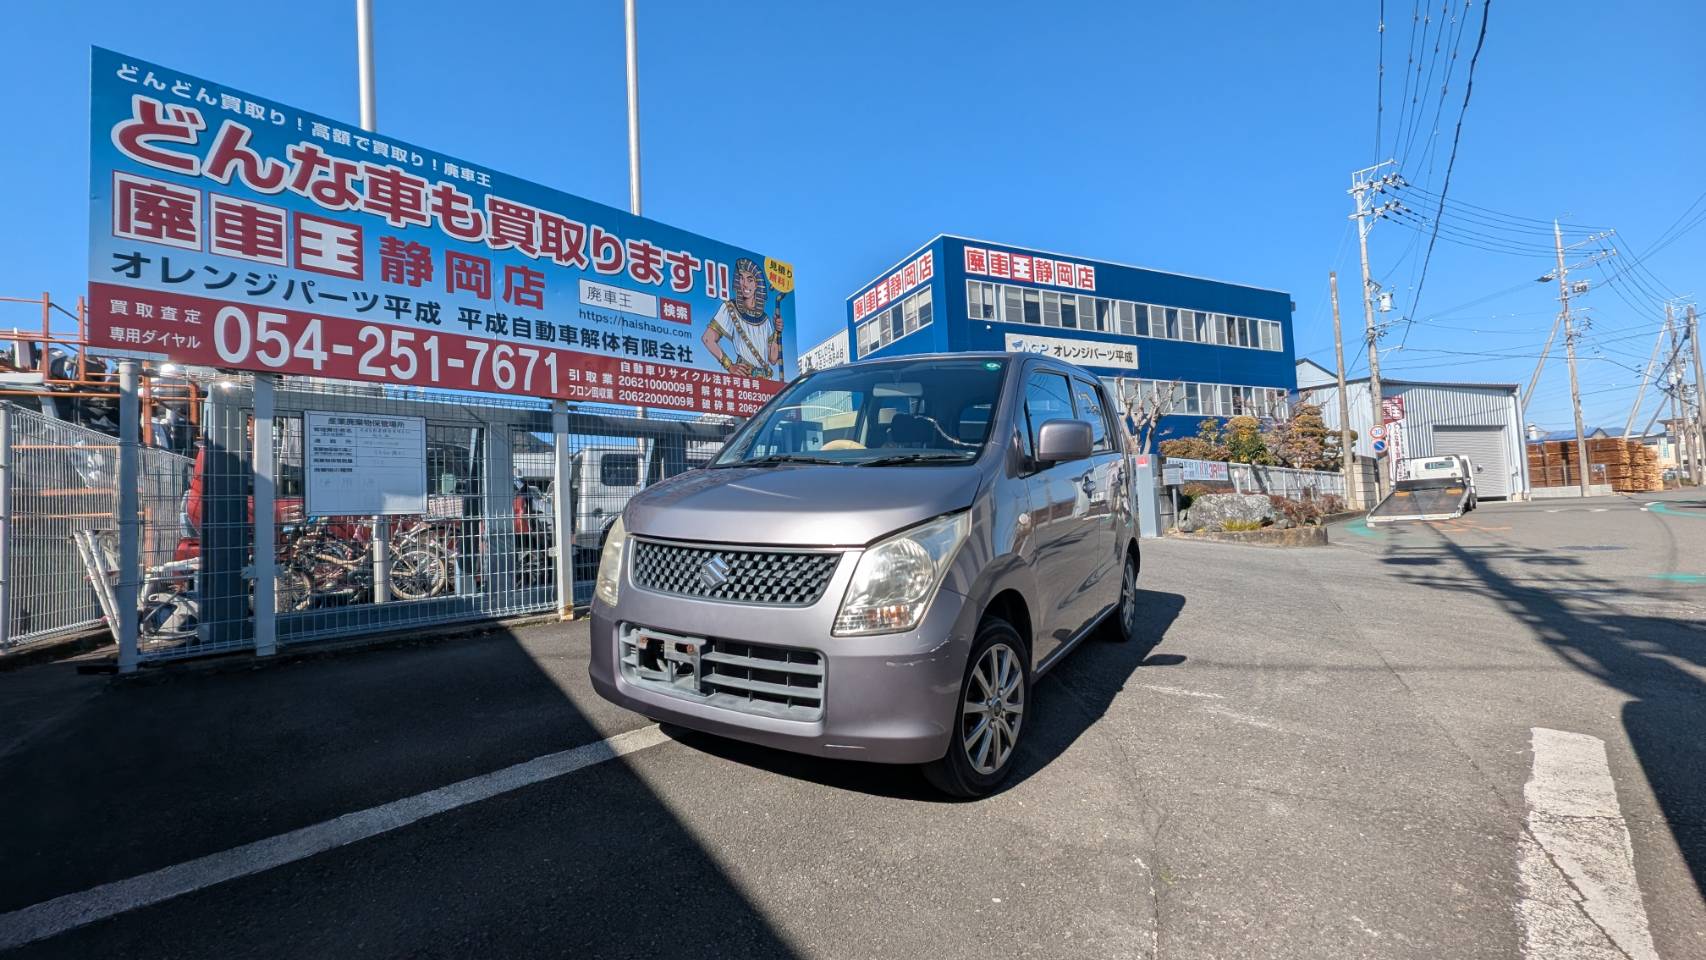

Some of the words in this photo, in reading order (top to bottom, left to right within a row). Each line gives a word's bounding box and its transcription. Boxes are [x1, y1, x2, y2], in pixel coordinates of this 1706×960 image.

[112, 170, 363, 281] 廃車王
[378, 235, 545, 310] 静岡店
[966, 248, 1094, 290] 廃車王静岡店
[110, 299, 202, 325] 買取査定
[111, 252, 442, 326] オレンジパーツ平成
[457, 306, 694, 364] 平成自動車解体有限会社
[587, 286, 633, 309] 廃車王
[663, 302, 689, 321] 検索
[109, 326, 201, 349] 専用ダイヤル
[578, 308, 693, 339] https://haishaou.com
[213, 305, 559, 394] 054-251-7671
[568, 368, 613, 385] 引取業
[618, 375, 694, 395] 20621000009号
[620, 361, 760, 390] 自動車リサイクル法許可番号
[618, 389, 694, 408] 20622000009号
